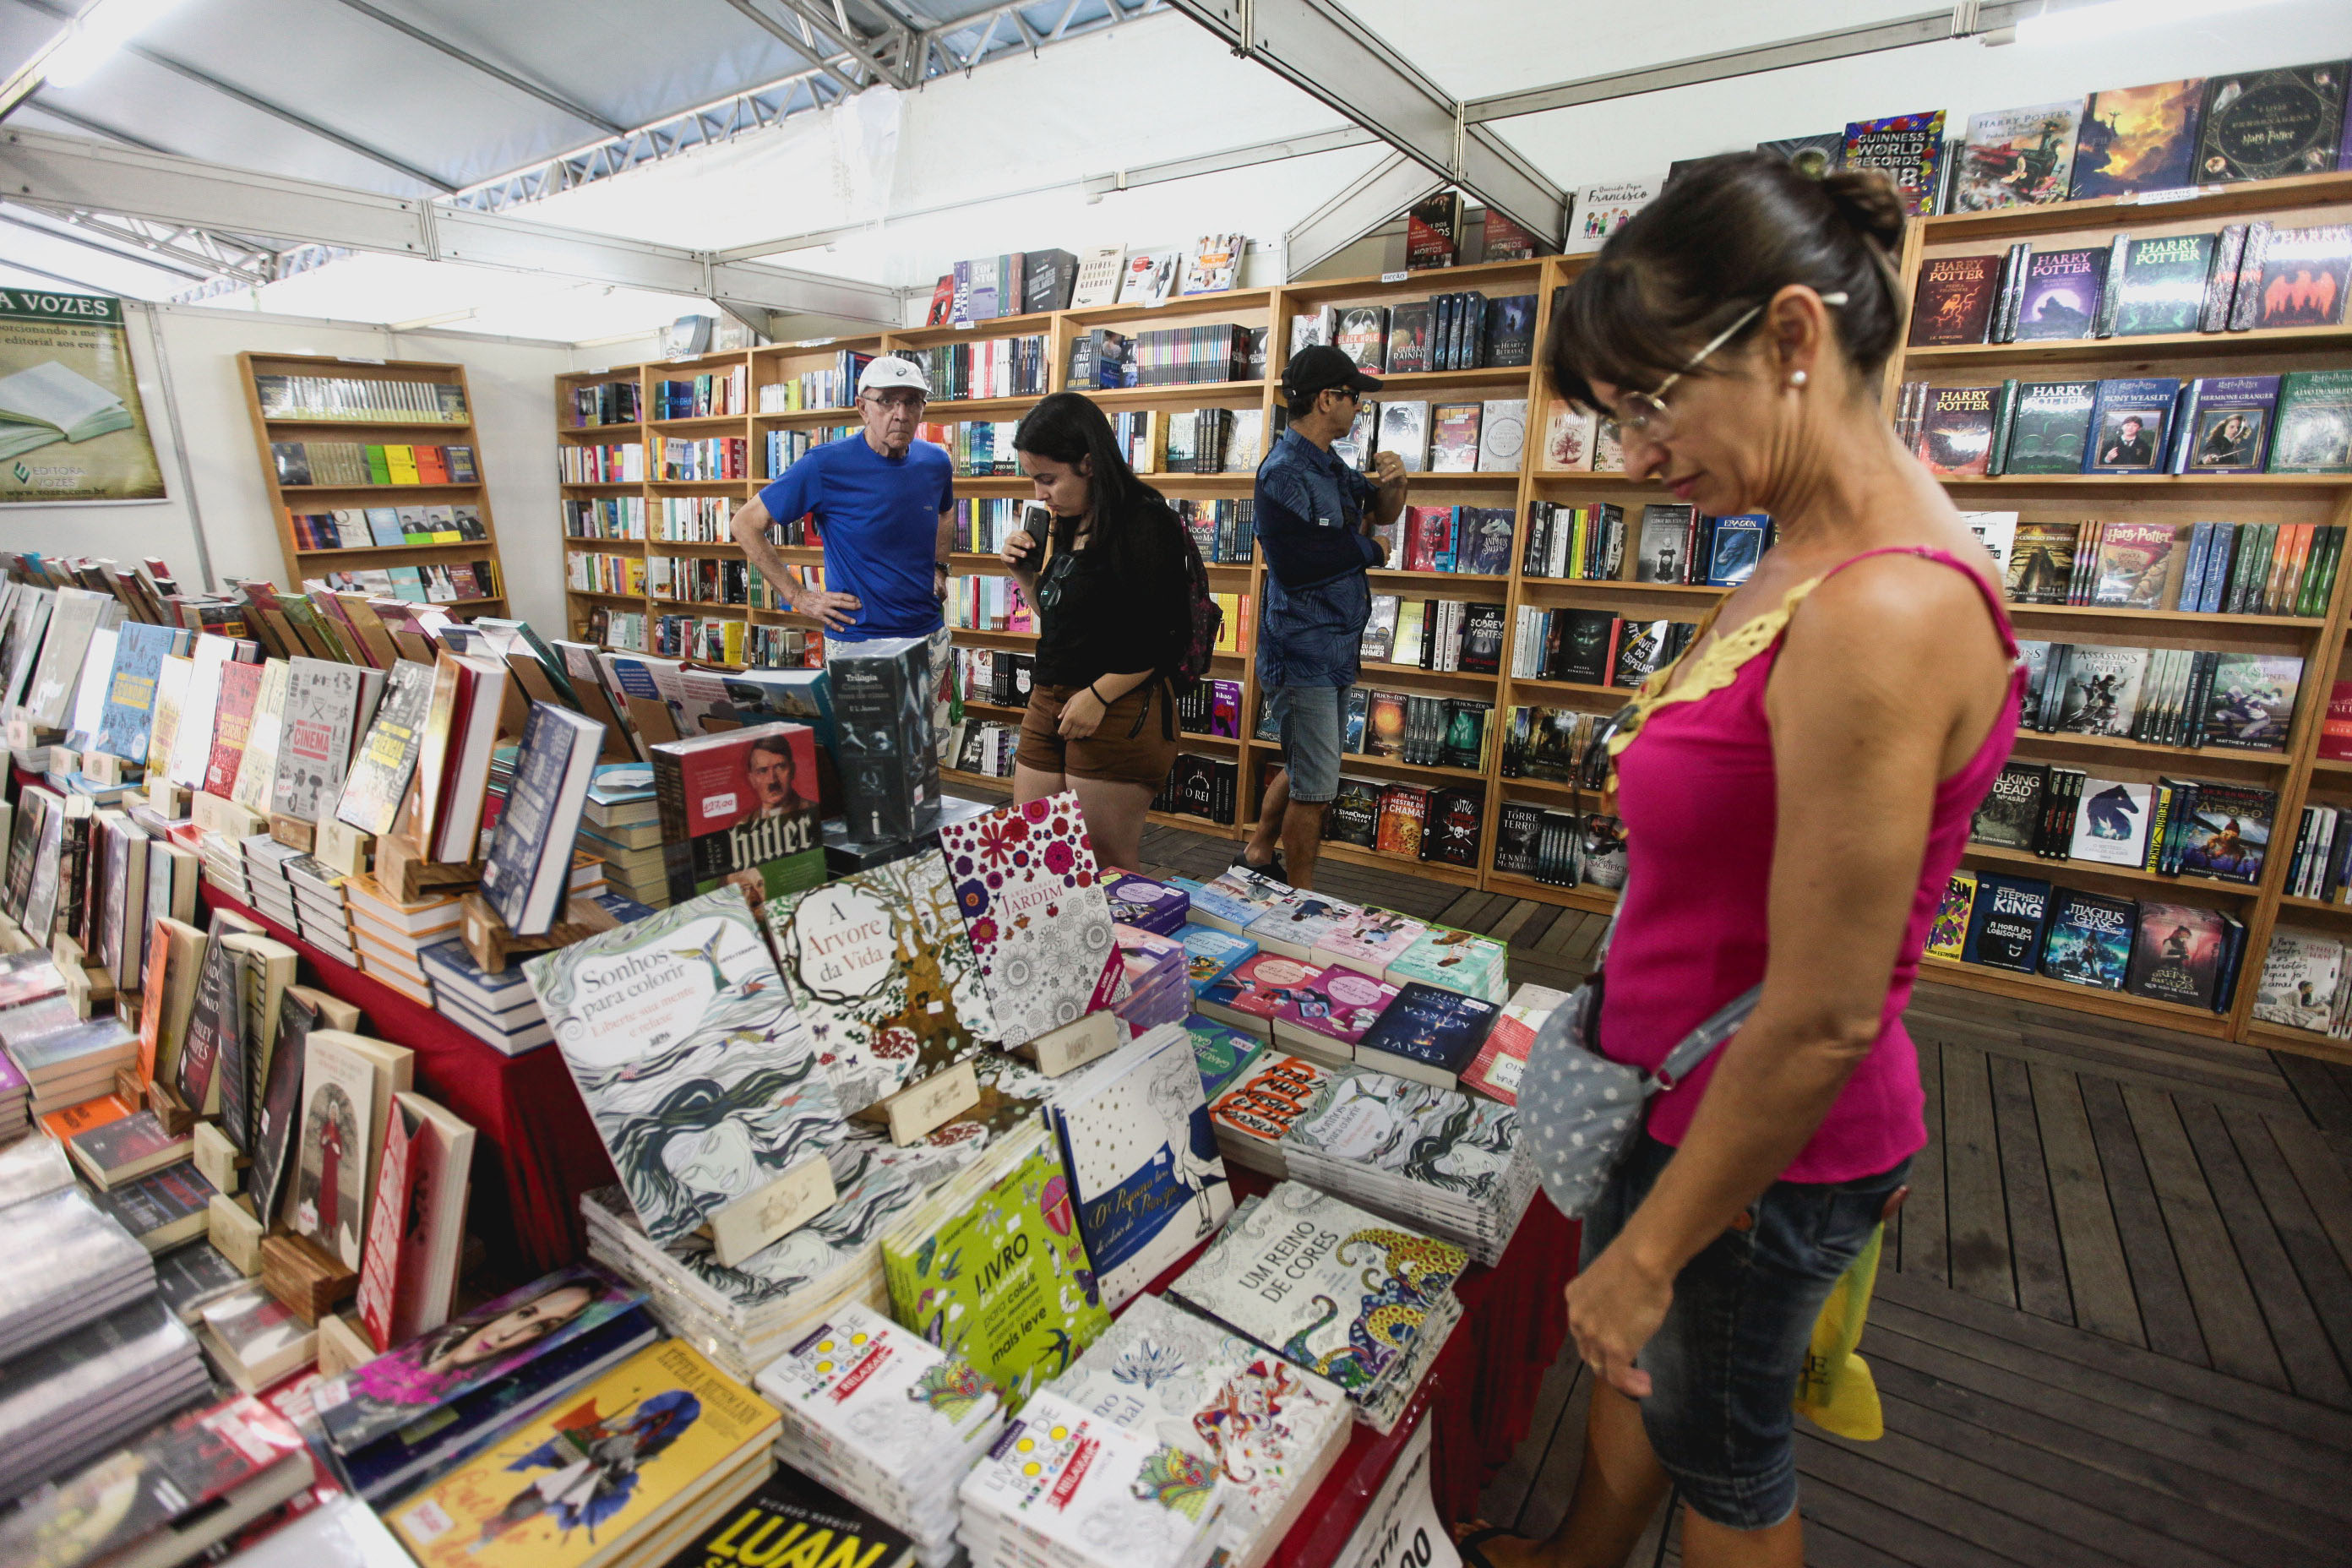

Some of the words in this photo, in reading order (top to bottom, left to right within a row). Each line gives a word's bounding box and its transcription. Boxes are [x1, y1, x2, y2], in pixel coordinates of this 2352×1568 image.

[1979, 117, 2020, 128] HARRY
[2024, 111, 2072, 122] POTTER
[1859, 133, 1925, 144] GUINNESS
[1858, 143, 1924, 155] WORLD
[1854, 155, 1921, 167] RECORDS
[1588, 189, 1648, 203] Francisco
[1414, 246, 1441, 255] MORTOS
[1491, 241, 1521, 250] MORTOS
[2142, 239, 2200, 253] HARRY
[2037, 253, 2092, 265] HARRY
[2135, 249, 2200, 264] POTTER
[1085, 261, 1111, 270] AVIÕES
[1935, 259, 1984, 272] HARRY
[2032, 262, 2091, 277] POTTER
[1082, 270, 1114, 280] GRANDES
[1930, 270, 1984, 282] POTTER
[1081, 280, 1112, 289] GUERRAS
[20, 293, 110, 317] VOZES
[1338, 335, 1358, 344] BLACK
[1360, 334, 1378, 342] HOLE
[1501, 340, 1520, 349] HEART
[1495, 347, 1524, 356] BETRAYAL
[1940, 391, 1990, 401] HARRY
[2033, 385, 2087, 397] HARRY
[2129, 394, 2170, 402] WEASLEY
[1936, 400, 1990, 411] POTTER
[33, 466, 85, 476] EDITORA
[36, 478, 75, 487] VOZES
[6, 487, 106, 497] www.vozes.com.br
[2106, 527, 2136, 542] Harry
[2137, 527, 2173, 543] Potter
[1635, 648, 1645, 658] DO
[1622, 651, 1654, 673] ESPELHO
[2085, 664, 2127, 673] UNITY
[295, 728, 330, 753] CINEMA
[1186, 787, 1192, 798] O
[1195, 789, 1209, 803] REI
[1993, 782, 2032, 797] DEAD
[1391, 798, 1414, 807] MESTRE
[1996, 793, 2026, 803] INVASÃO
[1339, 809, 1372, 820] STARCRAFT
[1389, 804, 1424, 818] CHAMAS
[1507, 810, 1538, 821] TORRE
[2197, 802, 2264, 819] APOLO
[1504, 819, 1542, 831] TERROR
[1001, 885, 1063, 918] JARDIM
[1996, 889, 2044, 905] STEPHEN
[829, 901, 847, 925] A
[1993, 897, 2043, 918] KING
[2069, 903, 2125, 925] MAGNUS
[1998, 923, 2018, 932] HORA
[2073, 914, 2115, 930] CHASE
[806, 917, 883, 961] Árvore
[1986, 928, 2032, 941] LOBISOMEM
[2303, 945, 2338, 954] JENNY
[581, 950, 670, 993] Sonhos
[820, 961, 841, 983] da
[840, 946, 884, 972] Vida
[2264, 961, 2307, 976] garotos
[2269, 972, 2287, 981] que
[582, 986, 625, 1022] para
[628, 962, 685, 999] colorir
[591, 1010, 635, 1037] Liberte
[638, 1003, 658, 1019] sua
[662, 985, 695, 1009] mente
[1404, 1005, 1470, 1028] MARCA
[1420, 1027, 1430, 1036] A
[1383, 1037, 1445, 1060] CRAVE
[1258, 1066, 1326, 1089] GREEN
[1258, 1078, 1313, 1100] JOHN
[1312, 1105, 1347, 1135] Sonhos
[1238, 1259, 1271, 1292] UM
[1266, 1221, 1316, 1263] REINO
[975, 1233, 1028, 1297] LIVRO
[1259, 1278, 1291, 1304] DE
[1285, 1230, 1339, 1281] CORES
[984, 1300, 1005, 1330] para
[1008, 1273, 1037, 1304] colorir
[836, 1315, 865, 1337] DE
[992, 1332, 1020, 1365] mais
[1021, 1309, 1048, 1336] leve
[1032, 1406, 1060, 1434] DE
[706, 1508, 888, 1568] LUAN
